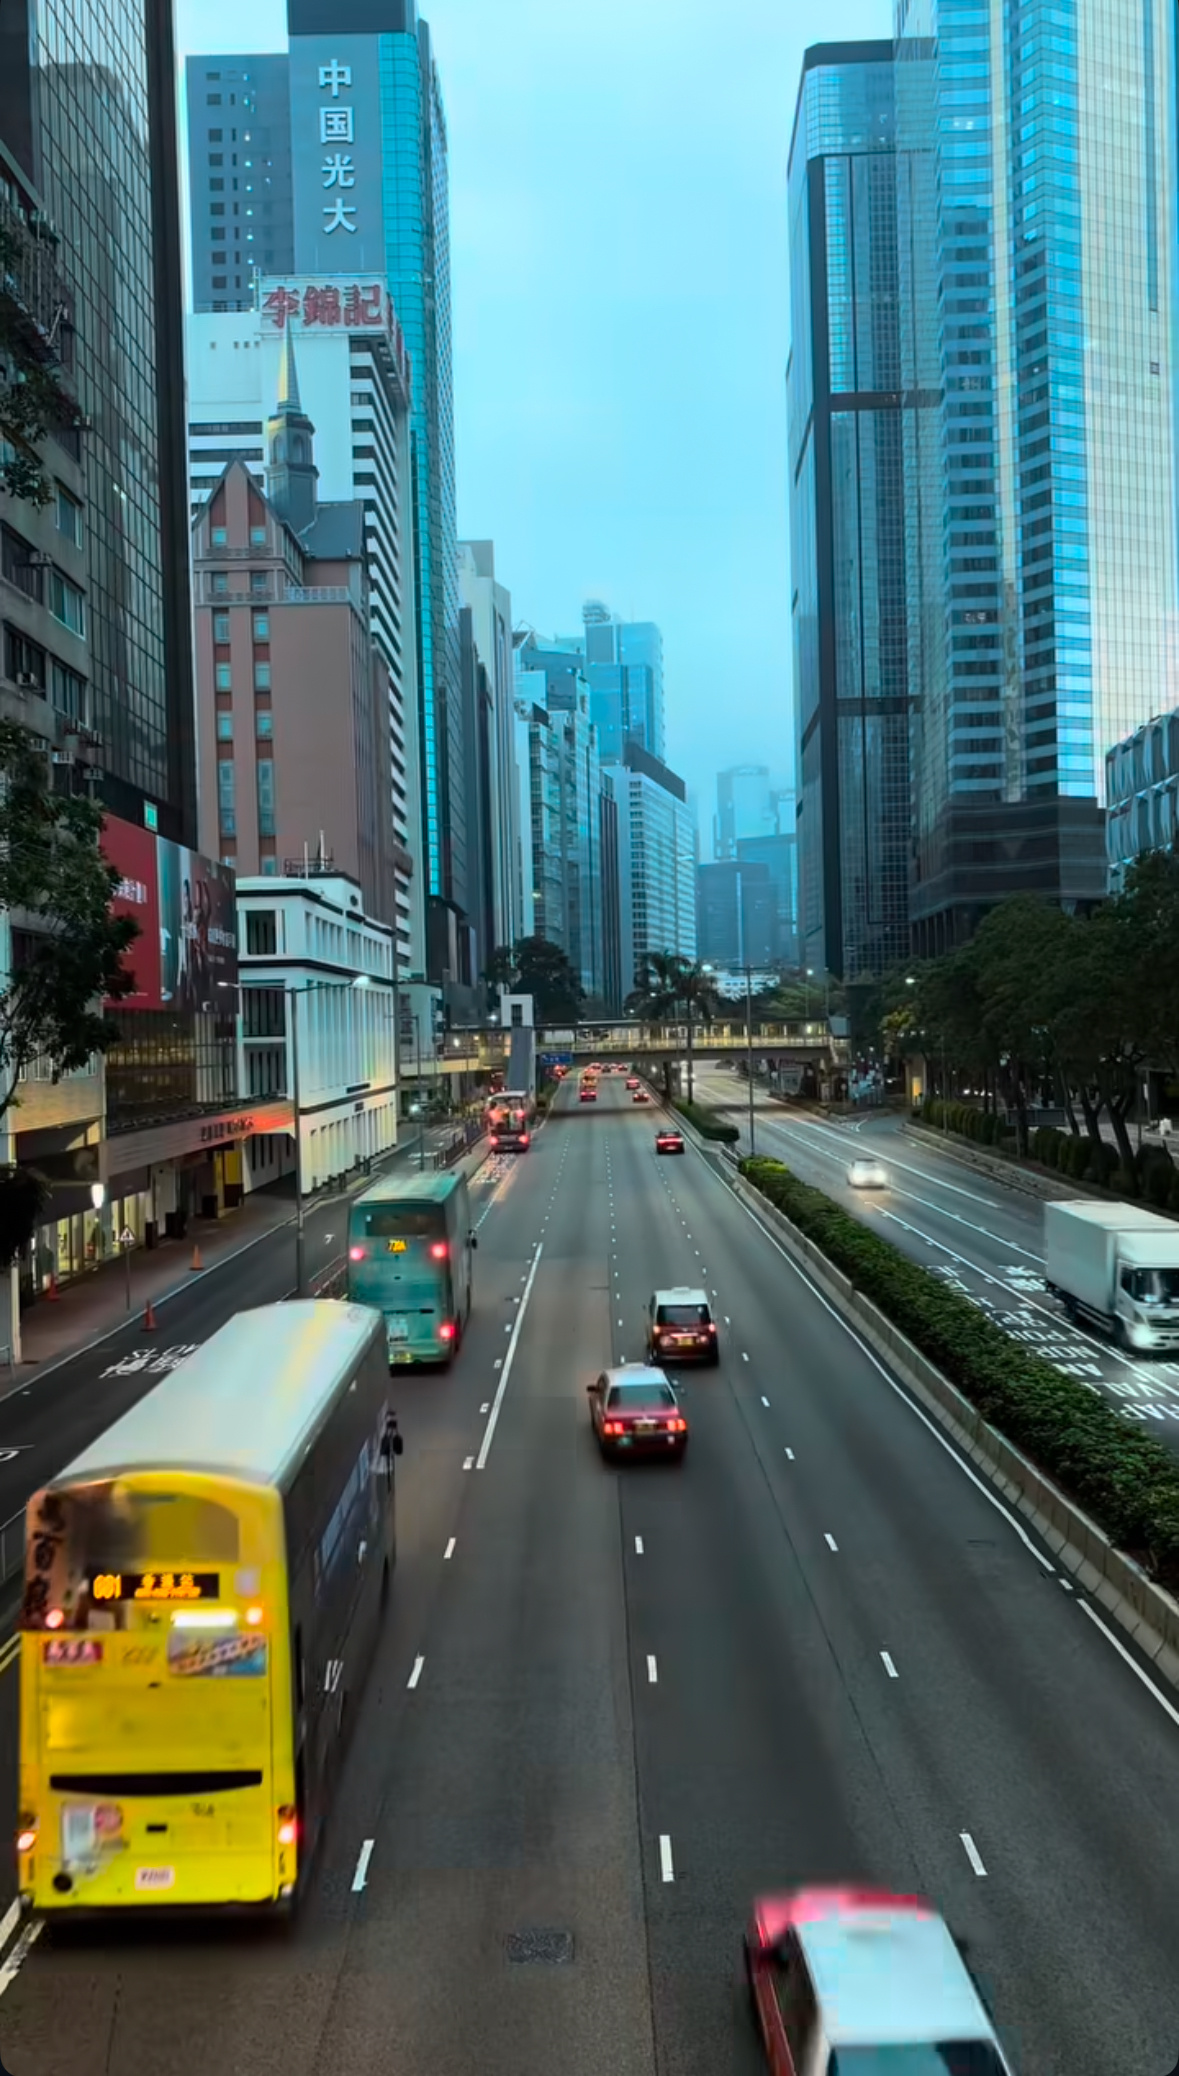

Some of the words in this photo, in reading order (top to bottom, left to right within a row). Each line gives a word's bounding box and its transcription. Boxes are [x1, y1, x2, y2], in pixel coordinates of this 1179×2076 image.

[318, 58, 358, 234] 中国光大
[261, 284, 383, 329] 李錦記
[1026, 1345, 1101, 1359] NOR
[1052, 1363, 1103, 1377] AN
